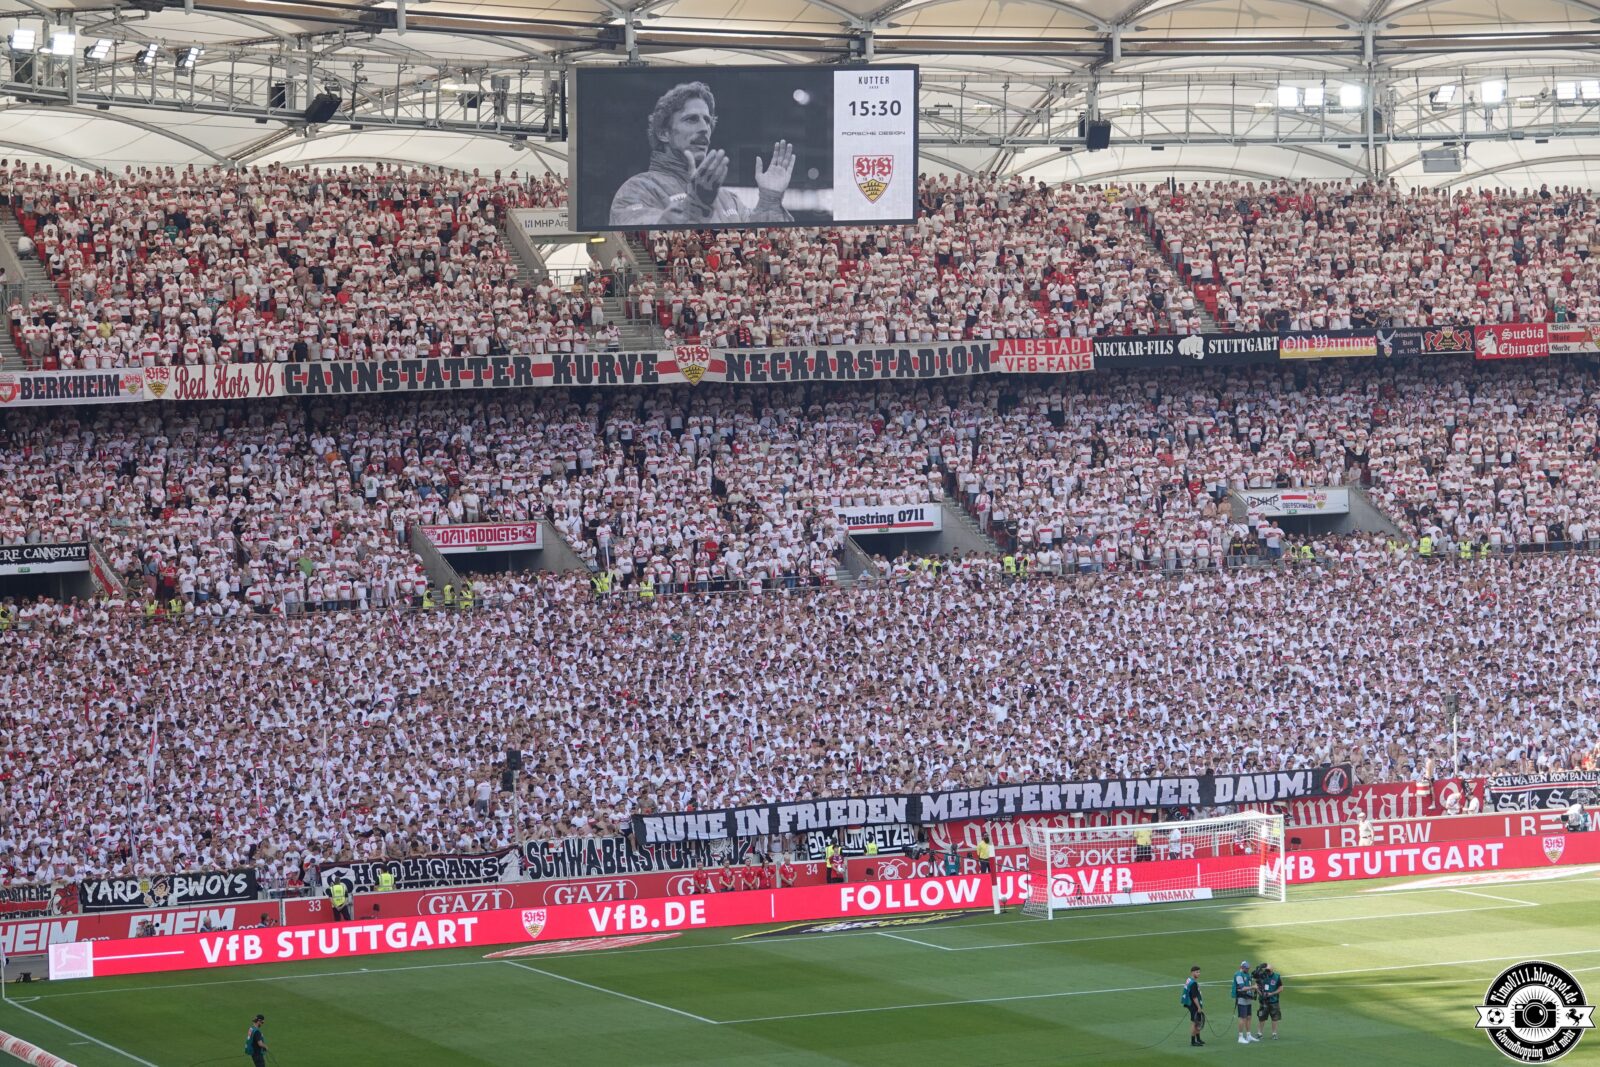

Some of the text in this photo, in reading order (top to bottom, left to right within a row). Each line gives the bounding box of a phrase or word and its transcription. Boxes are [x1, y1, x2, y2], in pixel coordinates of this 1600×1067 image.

[858, 76, 890, 85] KUTTER
[848, 100, 902, 116] 15:30
[534, 219, 568, 228] MHP Are
[1282, 333, 1377, 353] Old Warriors
[1501, 325, 1545, 342] Suebia
[1003, 337, 1094, 357] ALBSTADT
[1094, 336, 1280, 357] NECKAR-FILS STUTTGART
[284, 356, 534, 395] CANNSTATTER
[552, 353, 660, 386] KURVE
[725, 343, 992, 382] NECKARSTADION
[1004, 354, 1093, 373] VFB-FANS
[20, 374, 121, 400] BERKHEIM
[174, 362, 275, 400] Red Hots 96
[898, 508, 925, 523] 0711
[441, 529, 466, 544] 0711
[469, 527, 517, 543] ADDICTS
[23, 546, 87, 561] CANNSTATT
[1487, 770, 1598, 787] SCHWABEN KOMPANIE
[642, 812, 728, 843] RUHE
[735, 808, 770, 836] IN
[777, 797, 908, 833] FRIEDEN
[920, 777, 1200, 821] MEISTERTRAINER
[1213, 769, 1312, 803] DAUM!
[350, 857, 501, 886] HOOLIGANS
[806, 863, 818, 875] 34
[1264, 855, 1316, 882] VfB
[1327, 843, 1504, 878] STUTTGART
[83, 873, 248, 903] YARD BWOYS
[553, 881, 627, 905] GAZI
[841, 867, 1134, 911] FOLLOW US @VfB
[1146, 889, 1196, 902] WINAMAX
[308, 900, 321, 912] 33
[428, 891, 503, 915] GAZI
[1066, 894, 1114, 906] WINAMAX
[588, 899, 707, 932] VfB.DE
[199, 917, 479, 964] VfB STUTTGART
